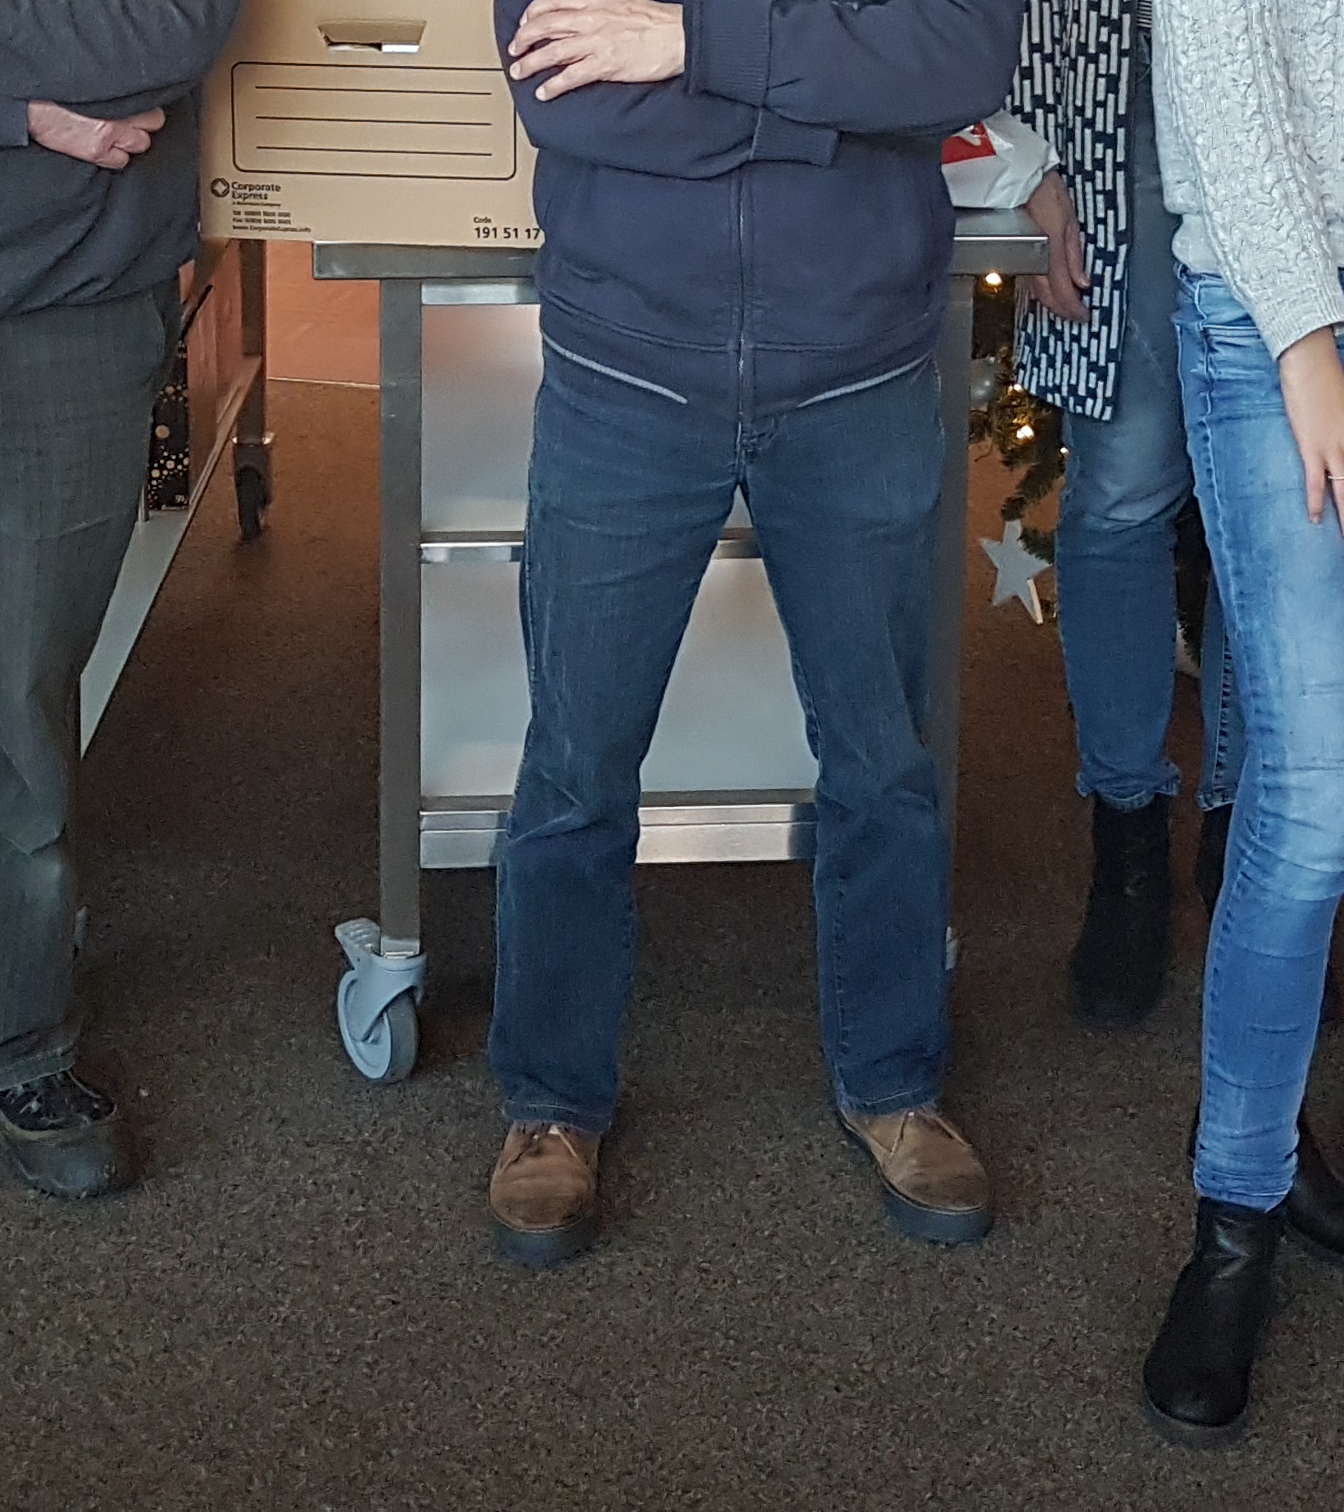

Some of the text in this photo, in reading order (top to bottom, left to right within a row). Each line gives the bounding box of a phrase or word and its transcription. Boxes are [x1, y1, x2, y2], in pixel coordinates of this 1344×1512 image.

[231, 181, 281, 192] Corporate
[231, 191, 268, 202] Express
[473, 216, 492, 224] Code
[475, 226, 541, 240] 191 51 17
